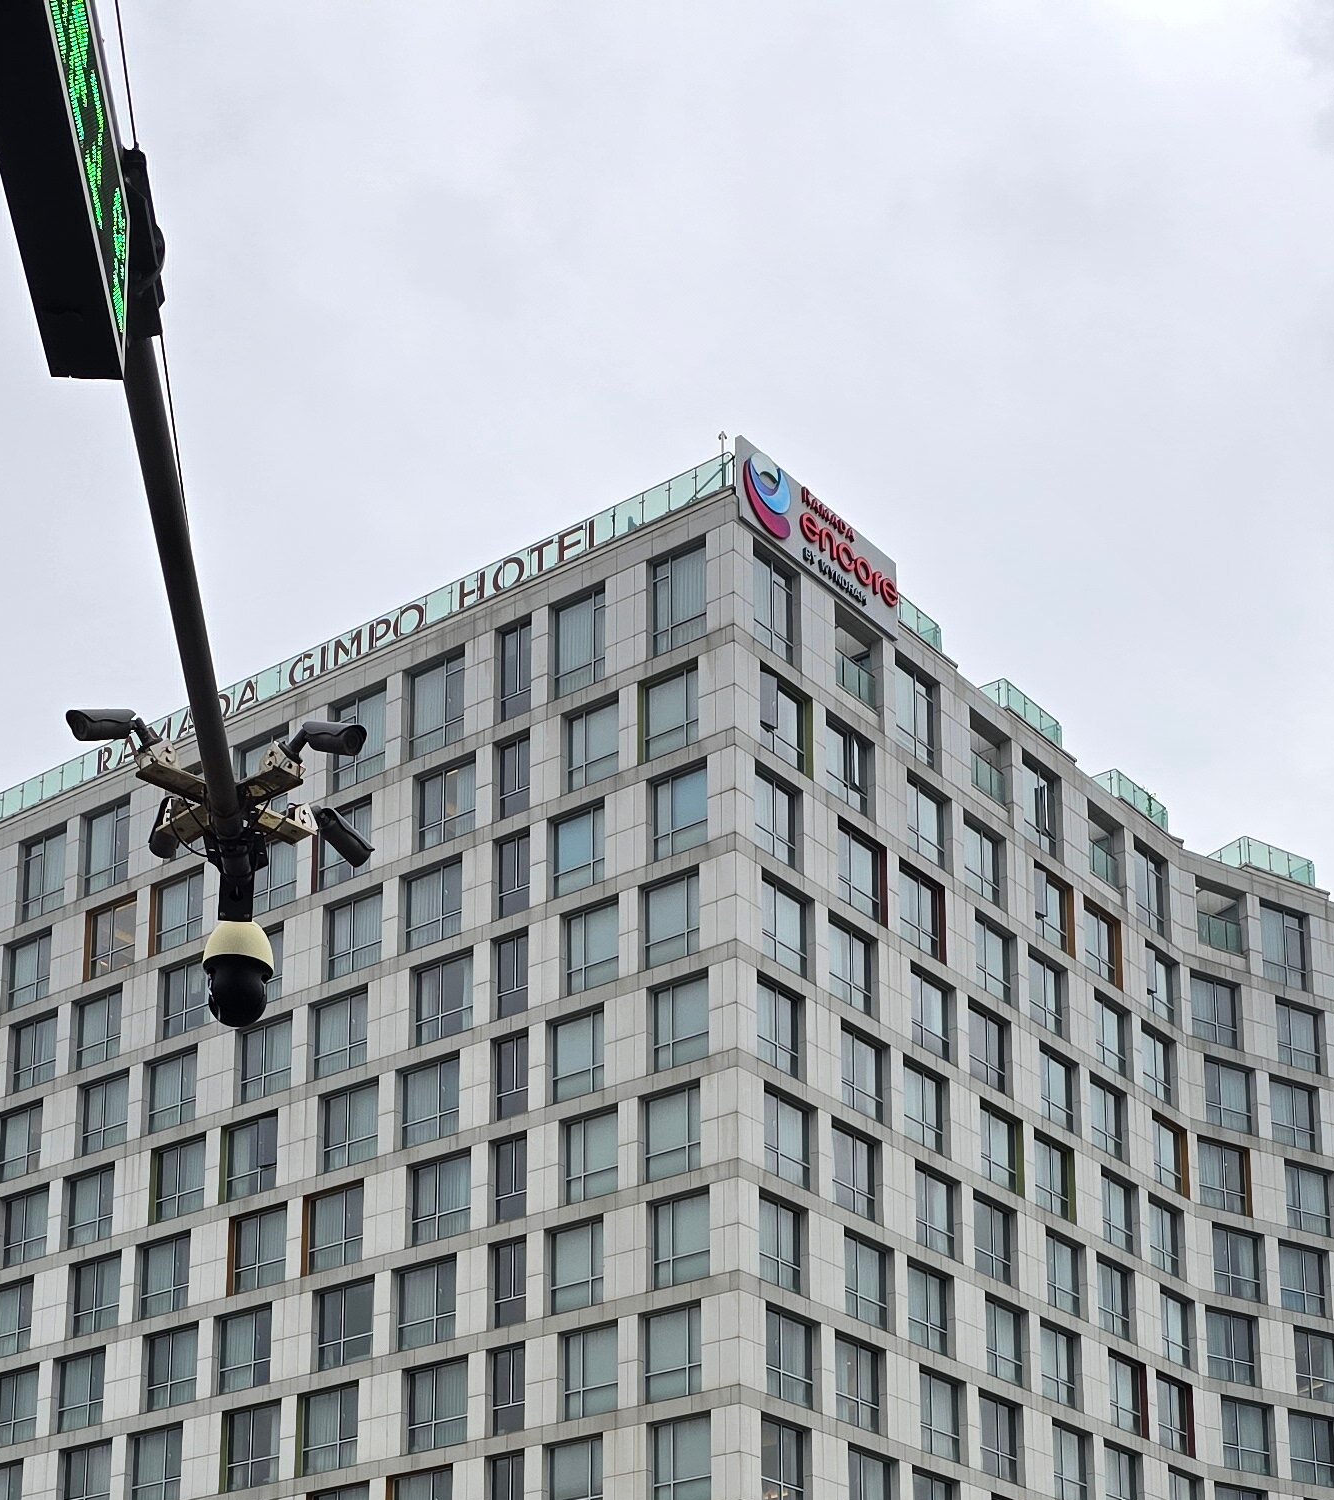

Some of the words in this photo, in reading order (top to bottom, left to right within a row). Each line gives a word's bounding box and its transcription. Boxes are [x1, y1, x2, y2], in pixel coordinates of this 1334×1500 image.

[801, 486, 854, 543] RAMADA
[799, 512, 898, 608] encore
[803, 547, 816, 566] BY
[817, 559, 867, 607] WYNDHAM
[288, 603, 424, 687] GIMPO
